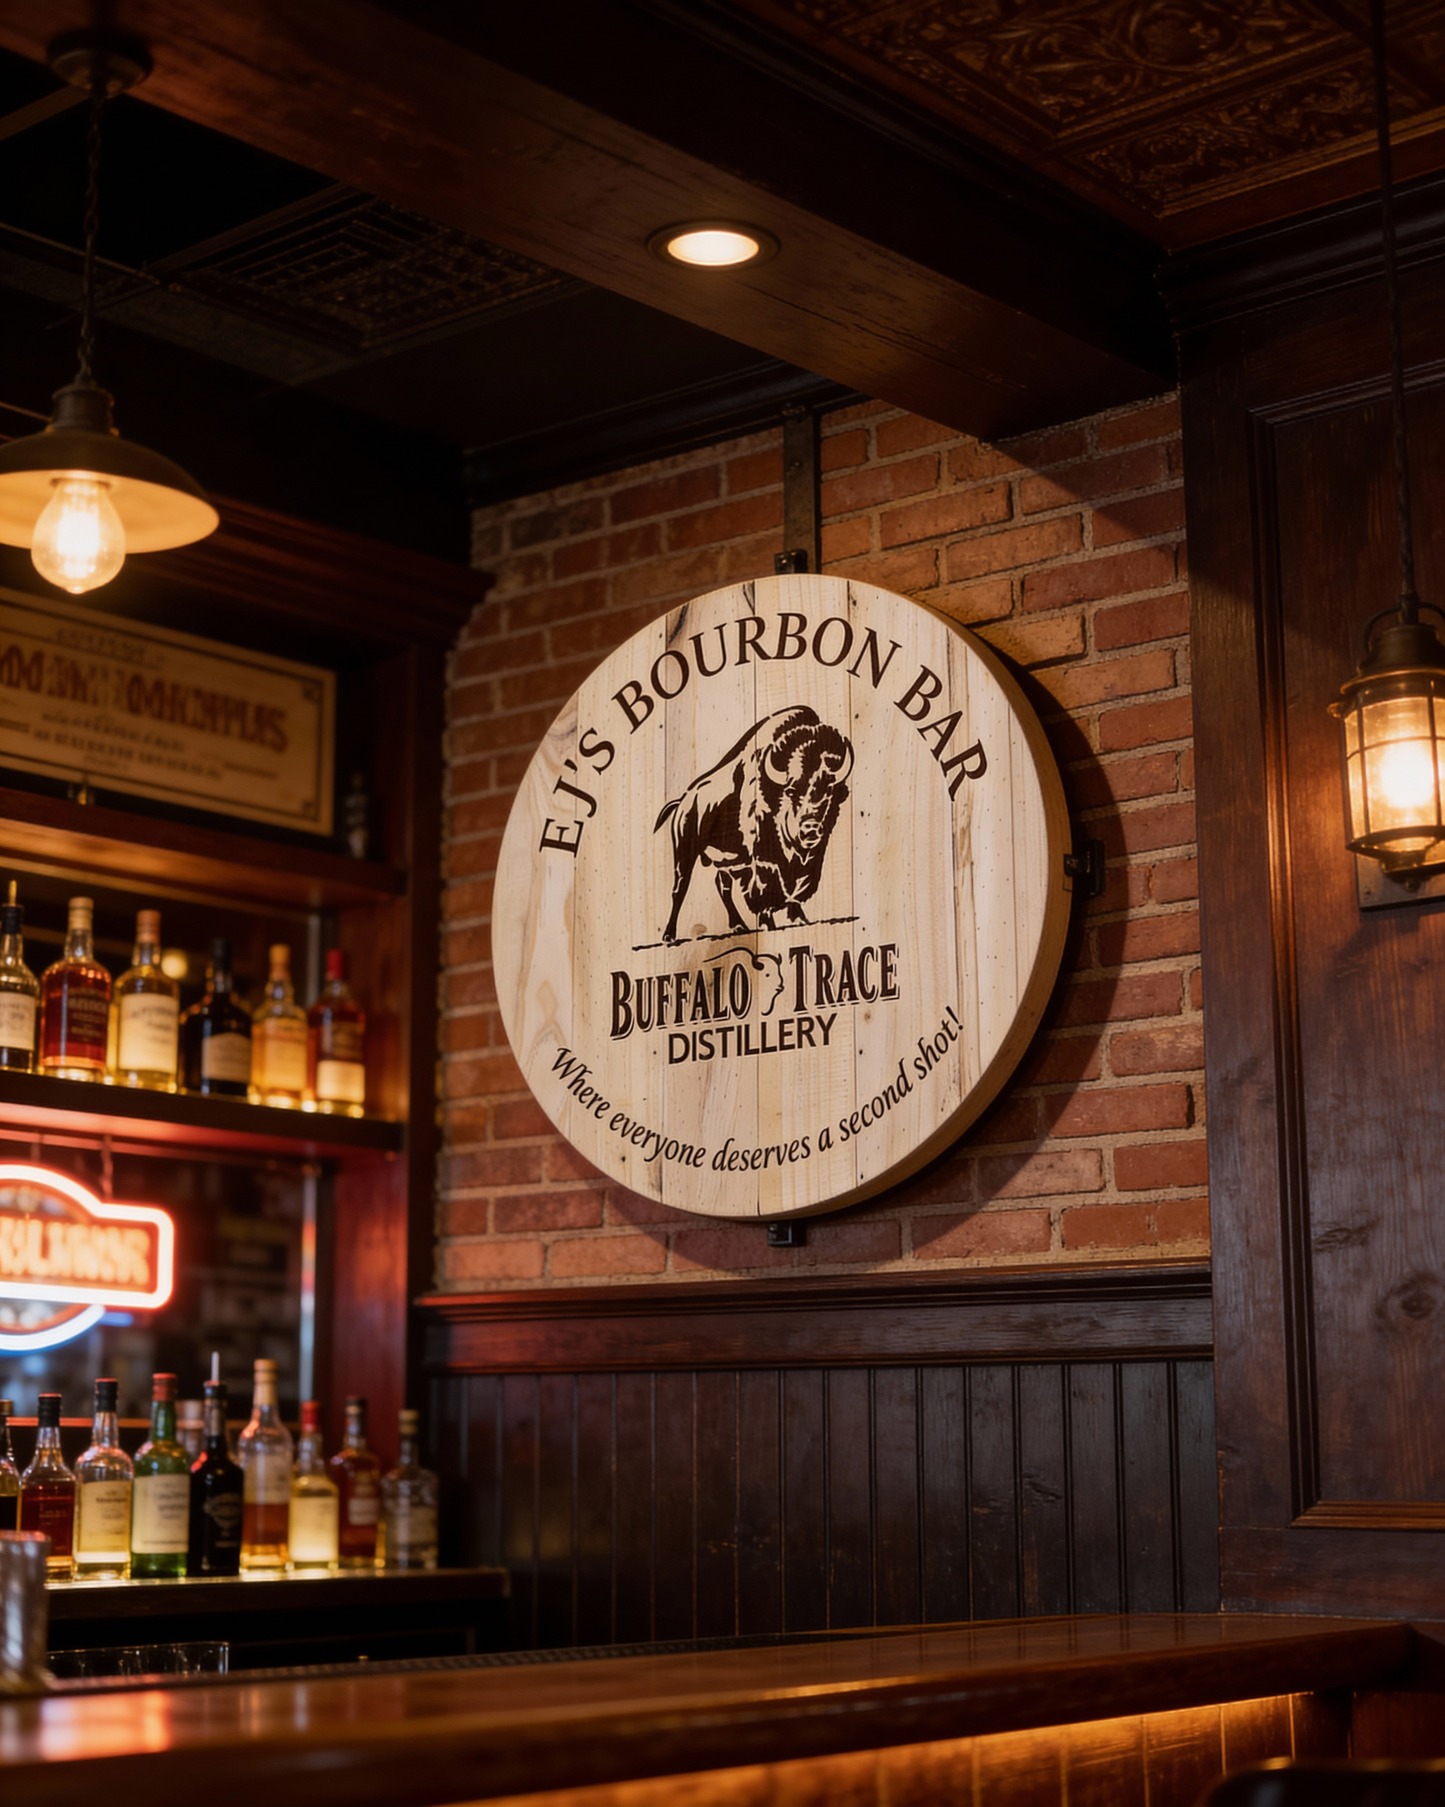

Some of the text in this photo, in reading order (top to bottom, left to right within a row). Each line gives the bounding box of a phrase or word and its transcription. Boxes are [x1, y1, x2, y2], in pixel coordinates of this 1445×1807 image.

[538, 612, 988, 858] EJ'S BOURBON BAR
[550, 1005, 965, 1172] Where everyone deserves a second shot!
[667, 1013, 838, 1065] DISTILLERY
